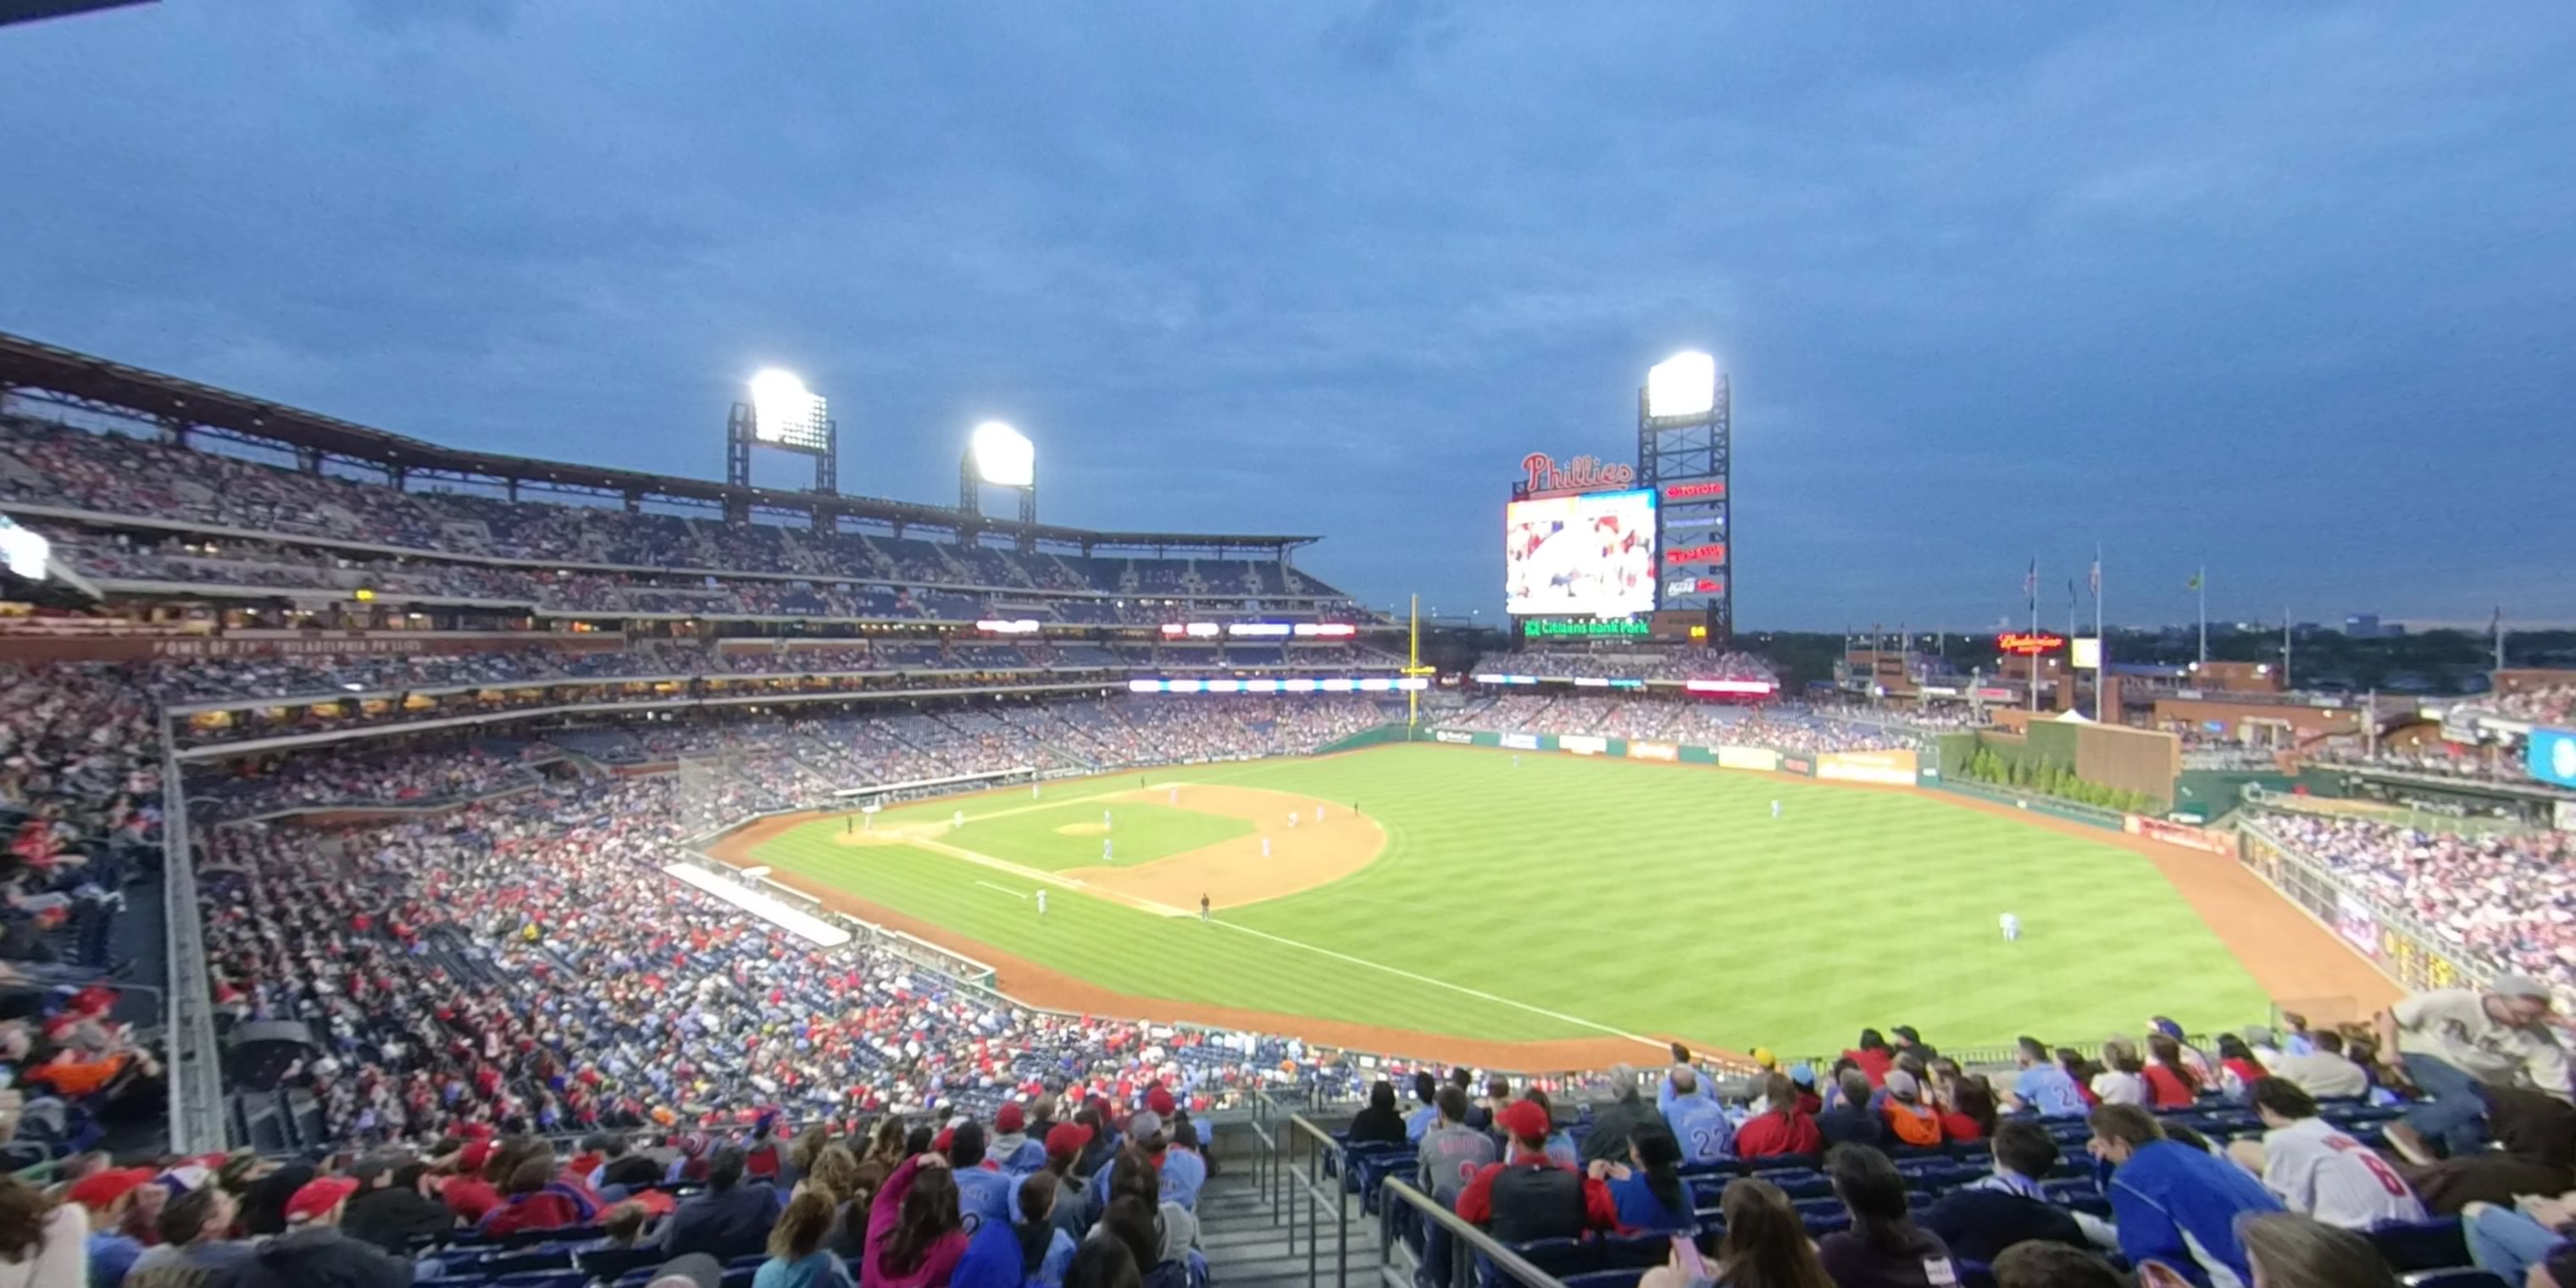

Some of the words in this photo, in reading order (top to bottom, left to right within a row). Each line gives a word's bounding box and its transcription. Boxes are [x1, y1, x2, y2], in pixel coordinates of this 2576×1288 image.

[1521, 452, 1633, 491] Phillies
[1542, 621, 1587, 634] Citizens
[1589, 622, 1619, 634] Bank
[1620, 622, 1650, 634] Park
